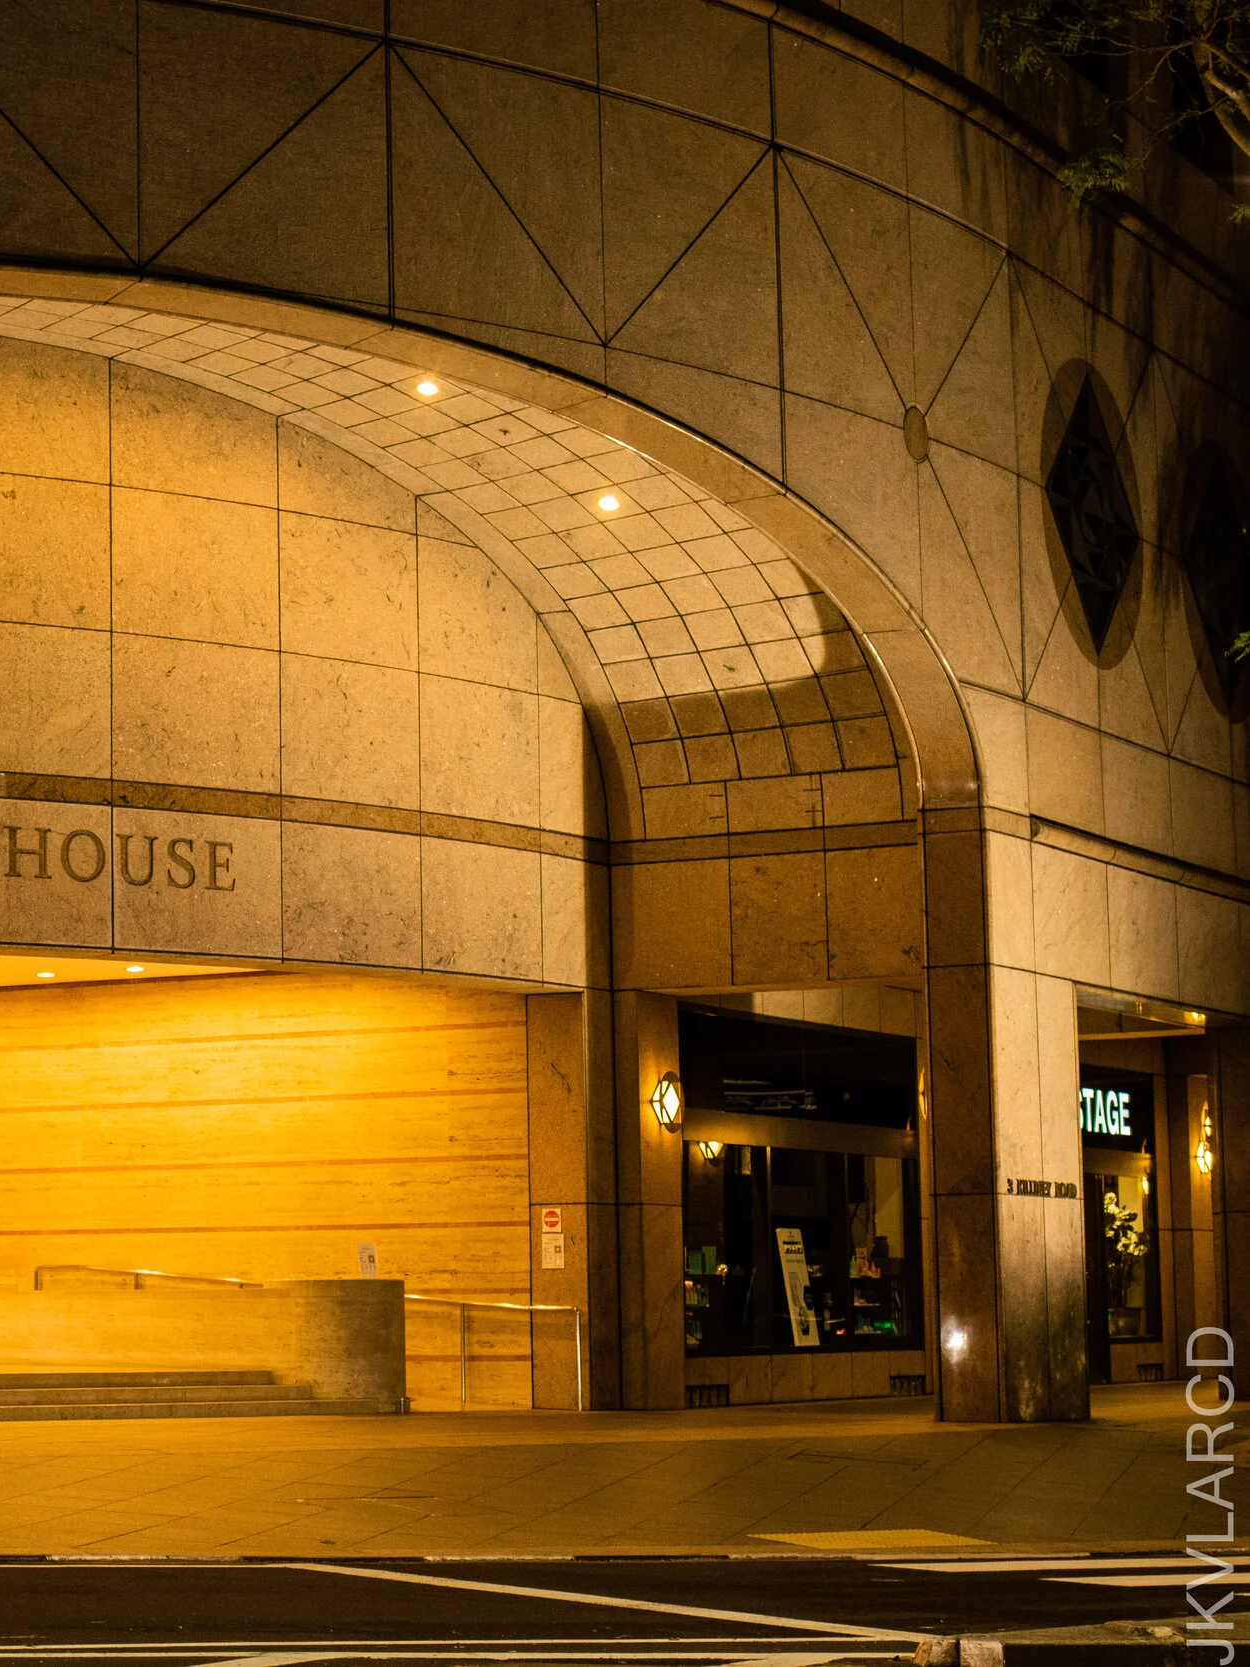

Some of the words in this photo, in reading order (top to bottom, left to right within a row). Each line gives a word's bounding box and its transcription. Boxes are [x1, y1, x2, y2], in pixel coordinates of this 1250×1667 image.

[4, 824, 237, 892] HOUSE
[1007, 1178, 1014, 1194] 3
[1054, 1182, 1078, 1198] ROAD
